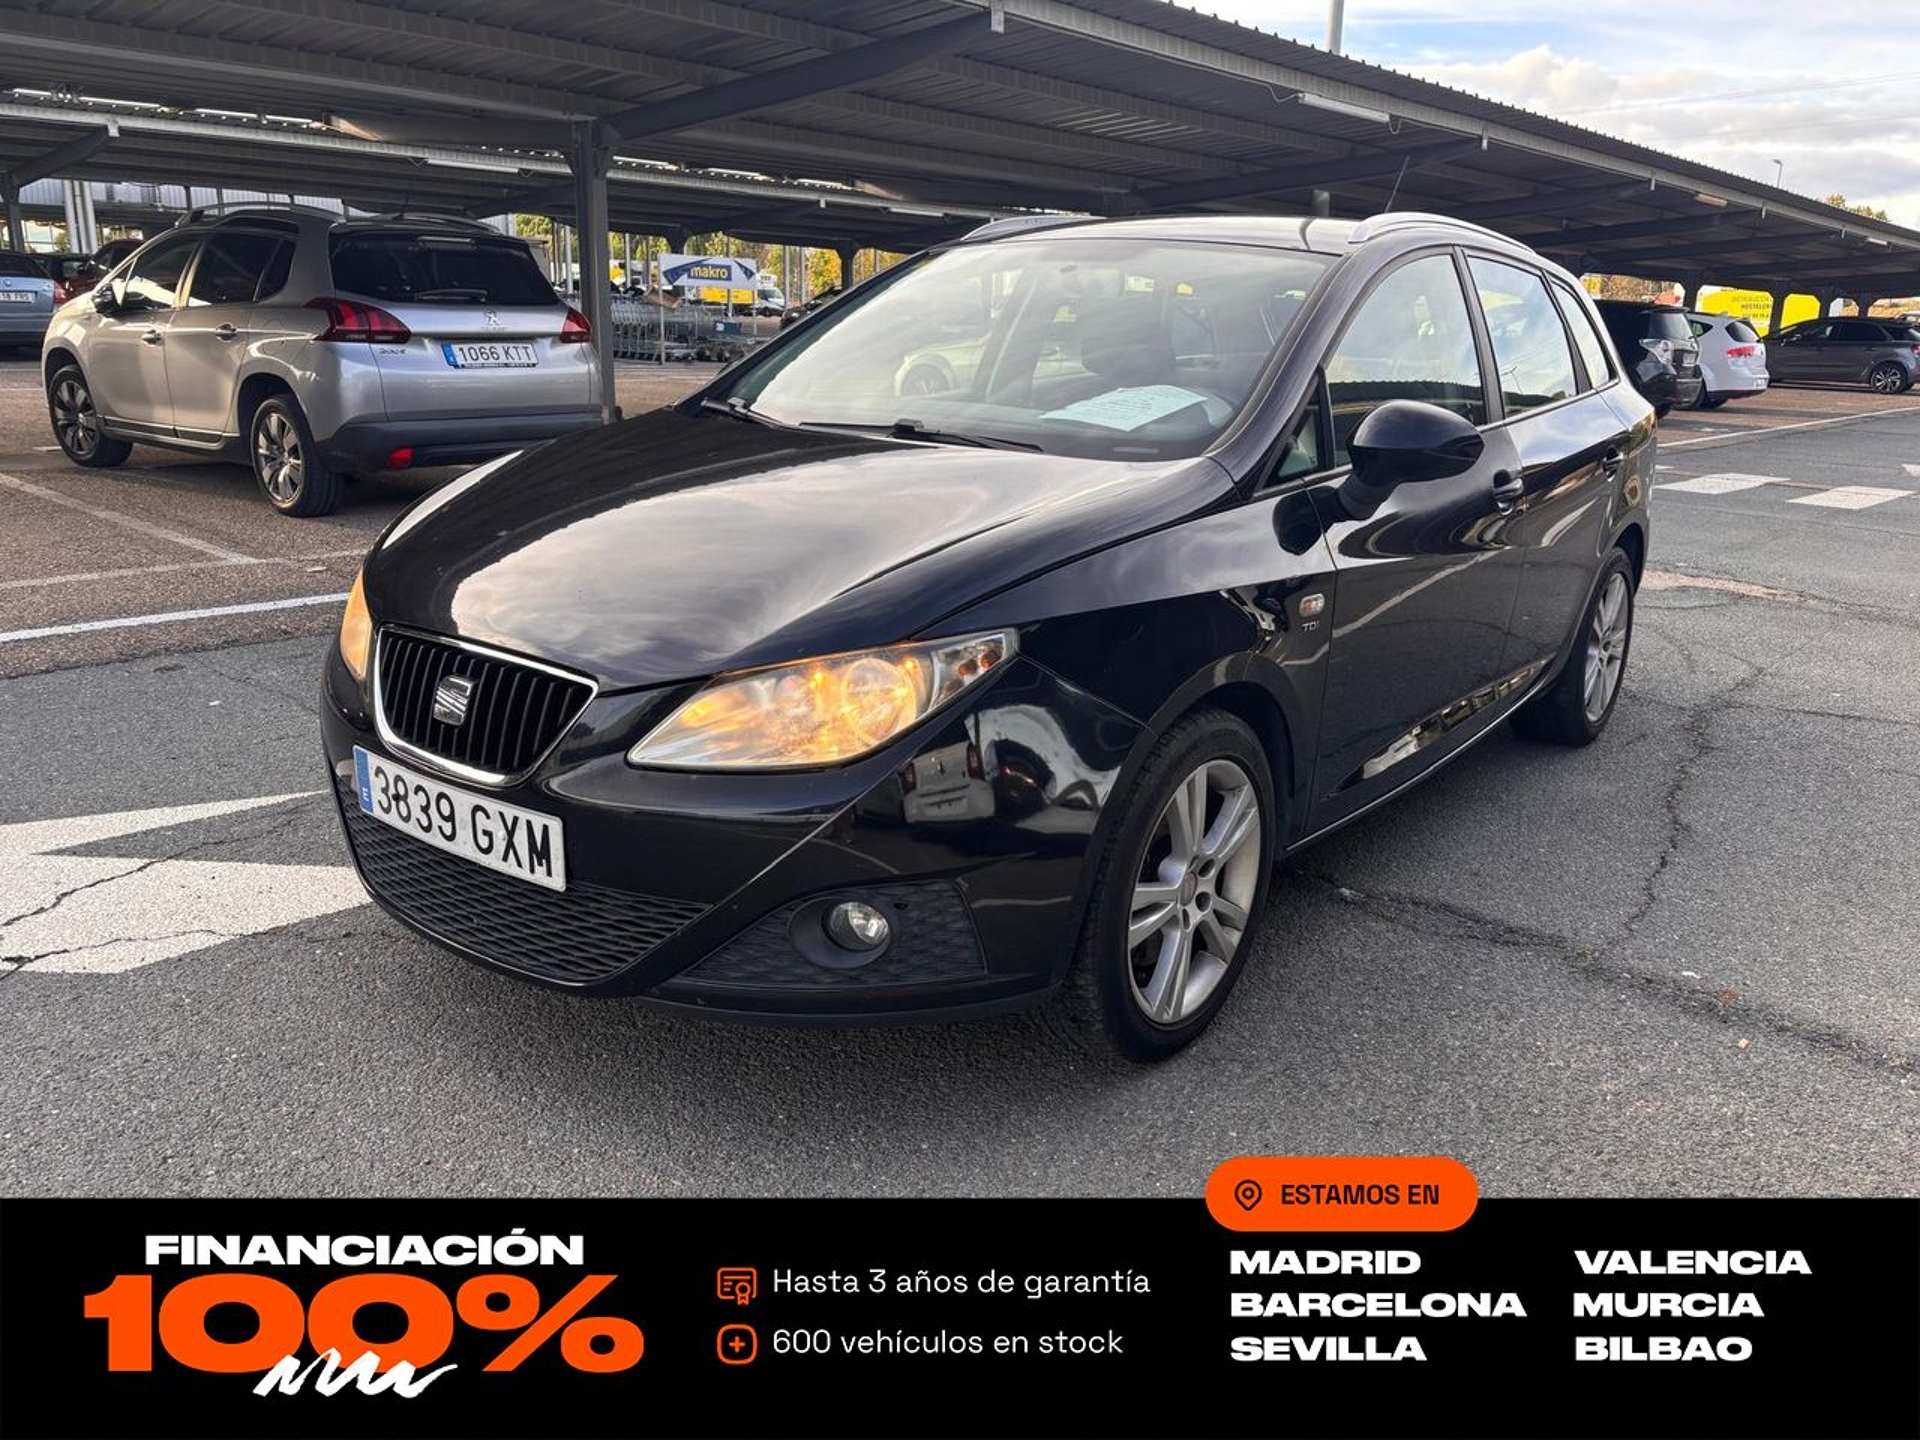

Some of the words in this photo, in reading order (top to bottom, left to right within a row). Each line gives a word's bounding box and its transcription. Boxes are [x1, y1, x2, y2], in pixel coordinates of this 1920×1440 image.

[690, 266, 728, 279] makro
[458, 345, 500, 362] 1066
[502, 345, 532, 361] KTT
[374, 765, 457, 842] 3839
[470, 804, 553, 878] GXM
